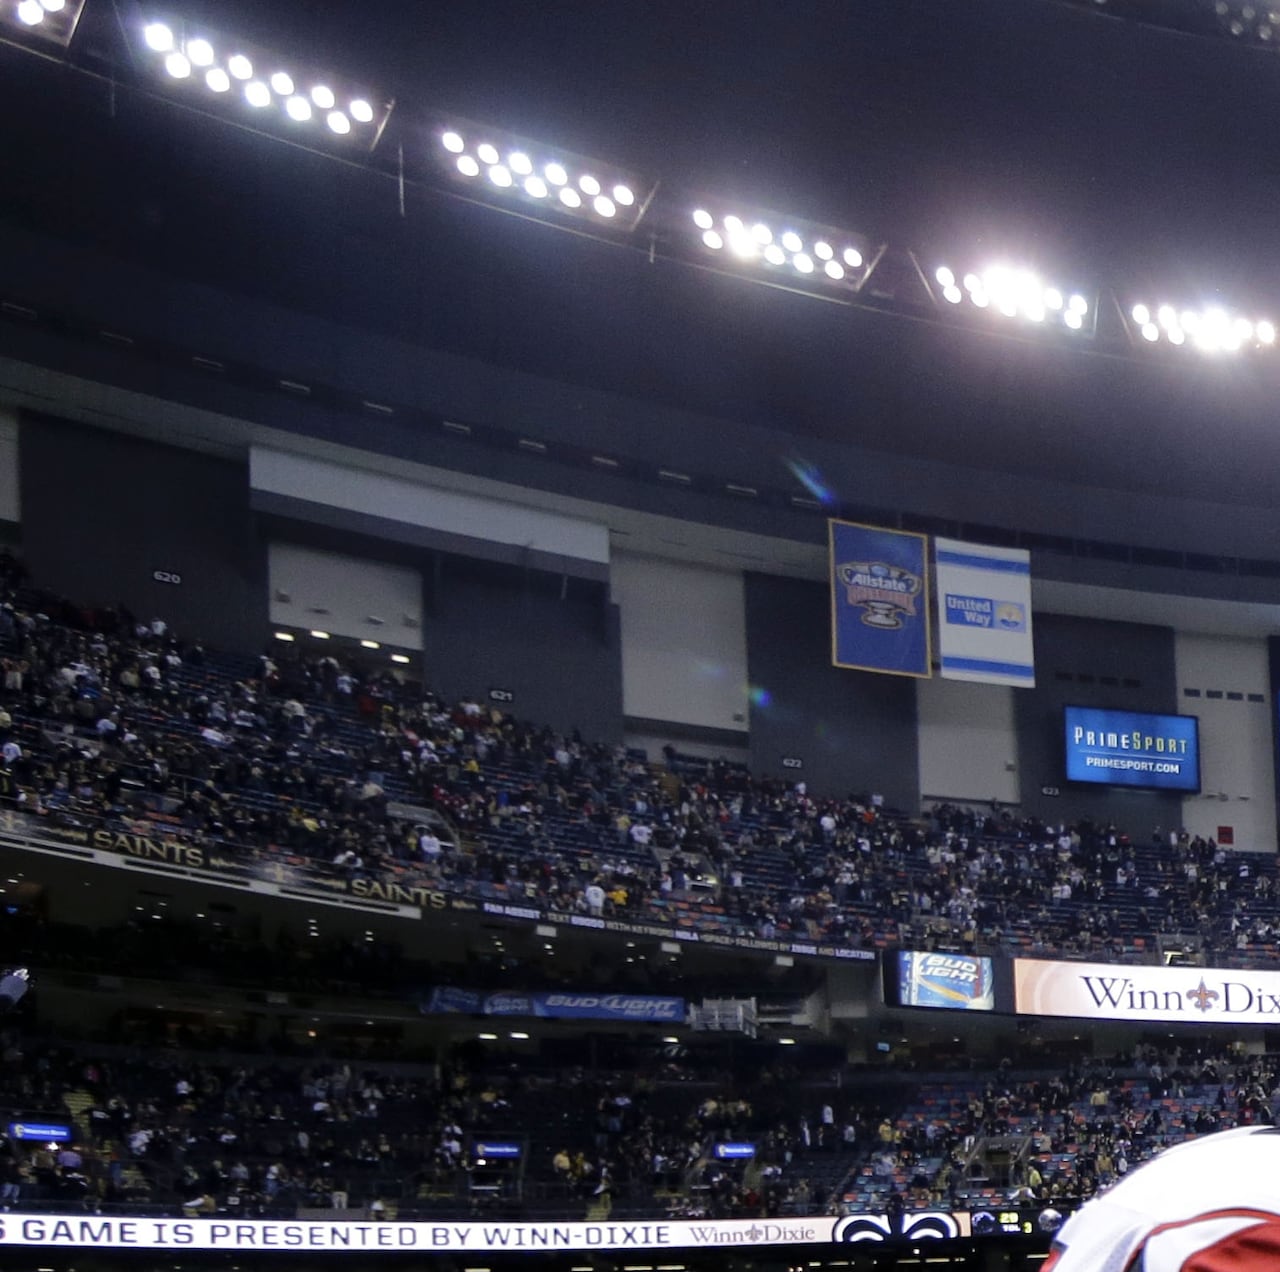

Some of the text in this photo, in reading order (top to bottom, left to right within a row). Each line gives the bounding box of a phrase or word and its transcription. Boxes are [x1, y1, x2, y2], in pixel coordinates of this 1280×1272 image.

[154, 571, 181, 584] 620
[851, 573, 906, 592] Allstate
[947, 597, 992, 612] United
[965, 611, 991, 626] Way
[1086, 757, 1180, 774] PRIMESPORT.COM
[93, 830, 204, 867] SAINTS
[351, 877, 446, 908] SAINTS
[926, 955, 977, 972] BUD
[919, 966, 979, 982] LIGHT
[546, 995, 600, 1008] BUD
[1080, 975, 1184, 1011] Winn
[607, 999, 677, 1010] LIGHT
[22, 1219, 138, 1243] GAME
[153, 1222, 194, 1244] IS
[210, 1225, 417, 1247] PRESENTED
[431, 1227, 471, 1246] BY
[483, 1225, 671, 1245] WINN-DIXIE
[689, 1226, 745, 1243] Winn
[763, 1224, 816, 1242] Dixie
